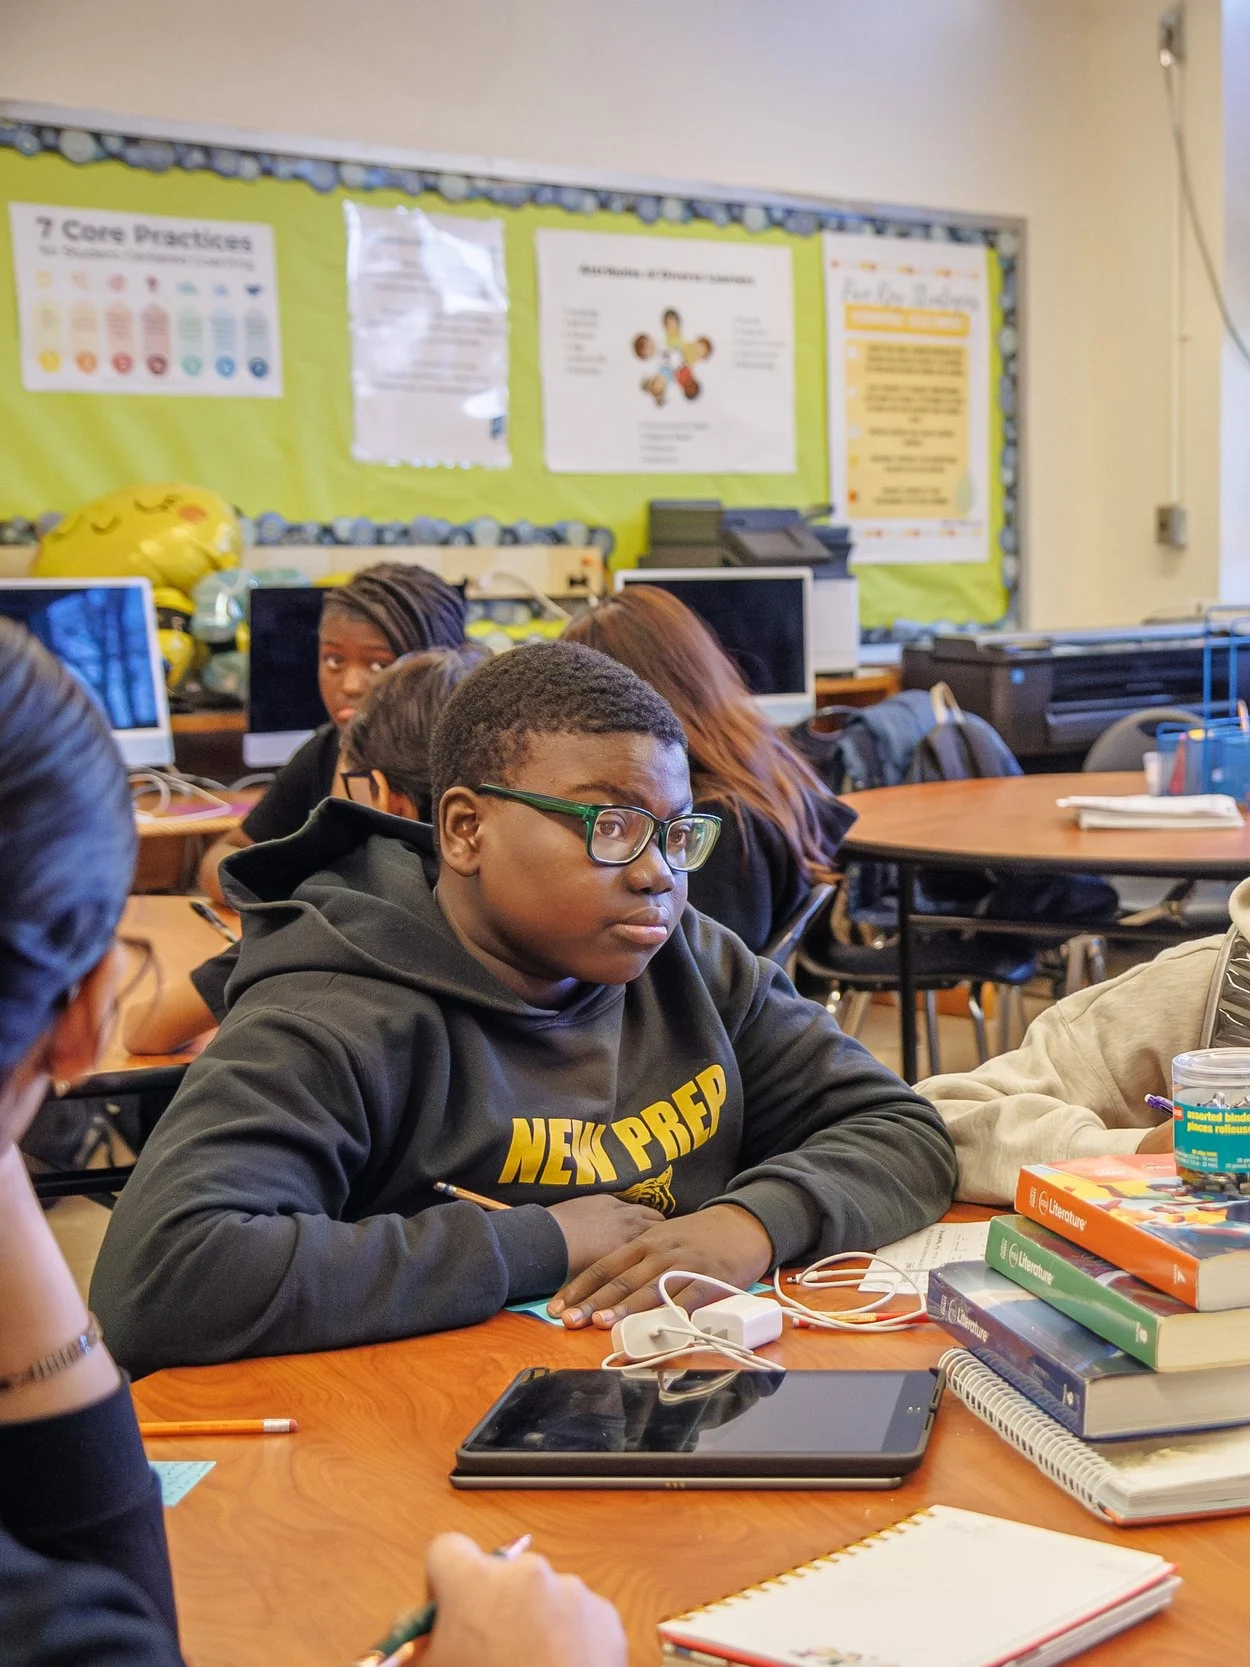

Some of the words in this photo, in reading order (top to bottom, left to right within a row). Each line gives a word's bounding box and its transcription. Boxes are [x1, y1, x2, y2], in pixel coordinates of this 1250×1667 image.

[35, 215, 53, 239] 7
[61, 219, 126, 245] Core
[133, 223, 254, 251] Practices
[498, 1118, 618, 1185] NEW
[611, 1064, 727, 1172] PREP
[1187, 1110, 1223, 1122] assorted
[1187, 1121, 1213, 1133] pinces
[1049, 1198, 1085, 1231] Literature
[1019, 1250, 1053, 1285] Literature
[956, 1308, 989, 1342] Literature
